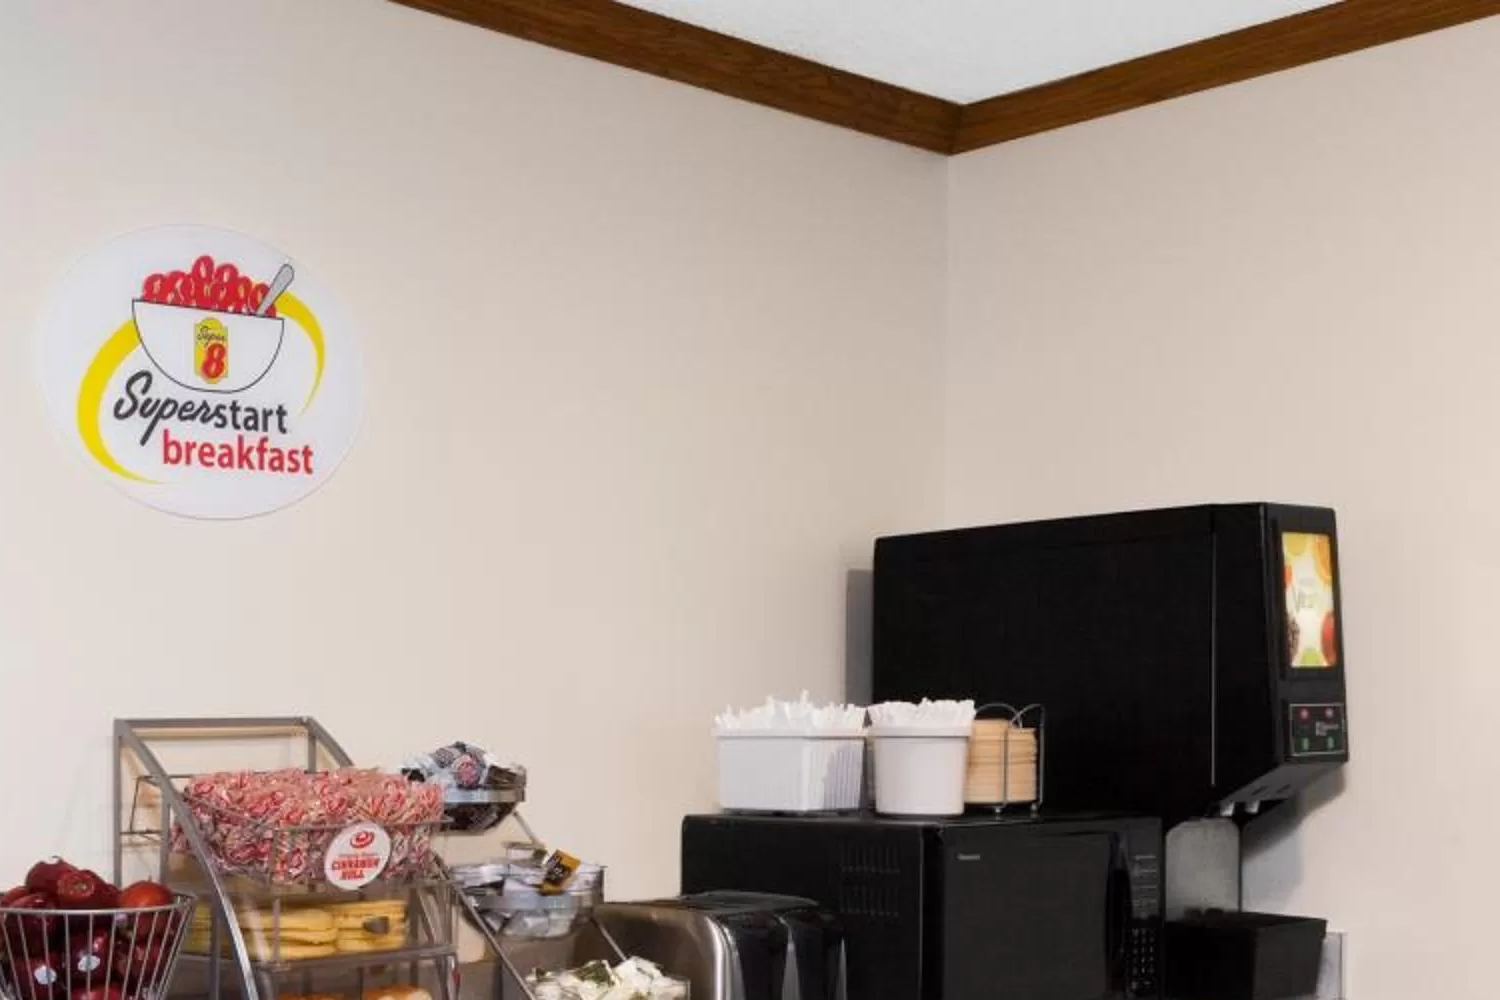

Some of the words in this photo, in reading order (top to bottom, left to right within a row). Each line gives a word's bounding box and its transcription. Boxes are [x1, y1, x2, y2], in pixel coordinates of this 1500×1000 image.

[197, 325, 225, 348] Super
[203, 343, 225, 379] 8
[112, 369, 289, 447] Superstart
[162, 428, 314, 475] breakfast
